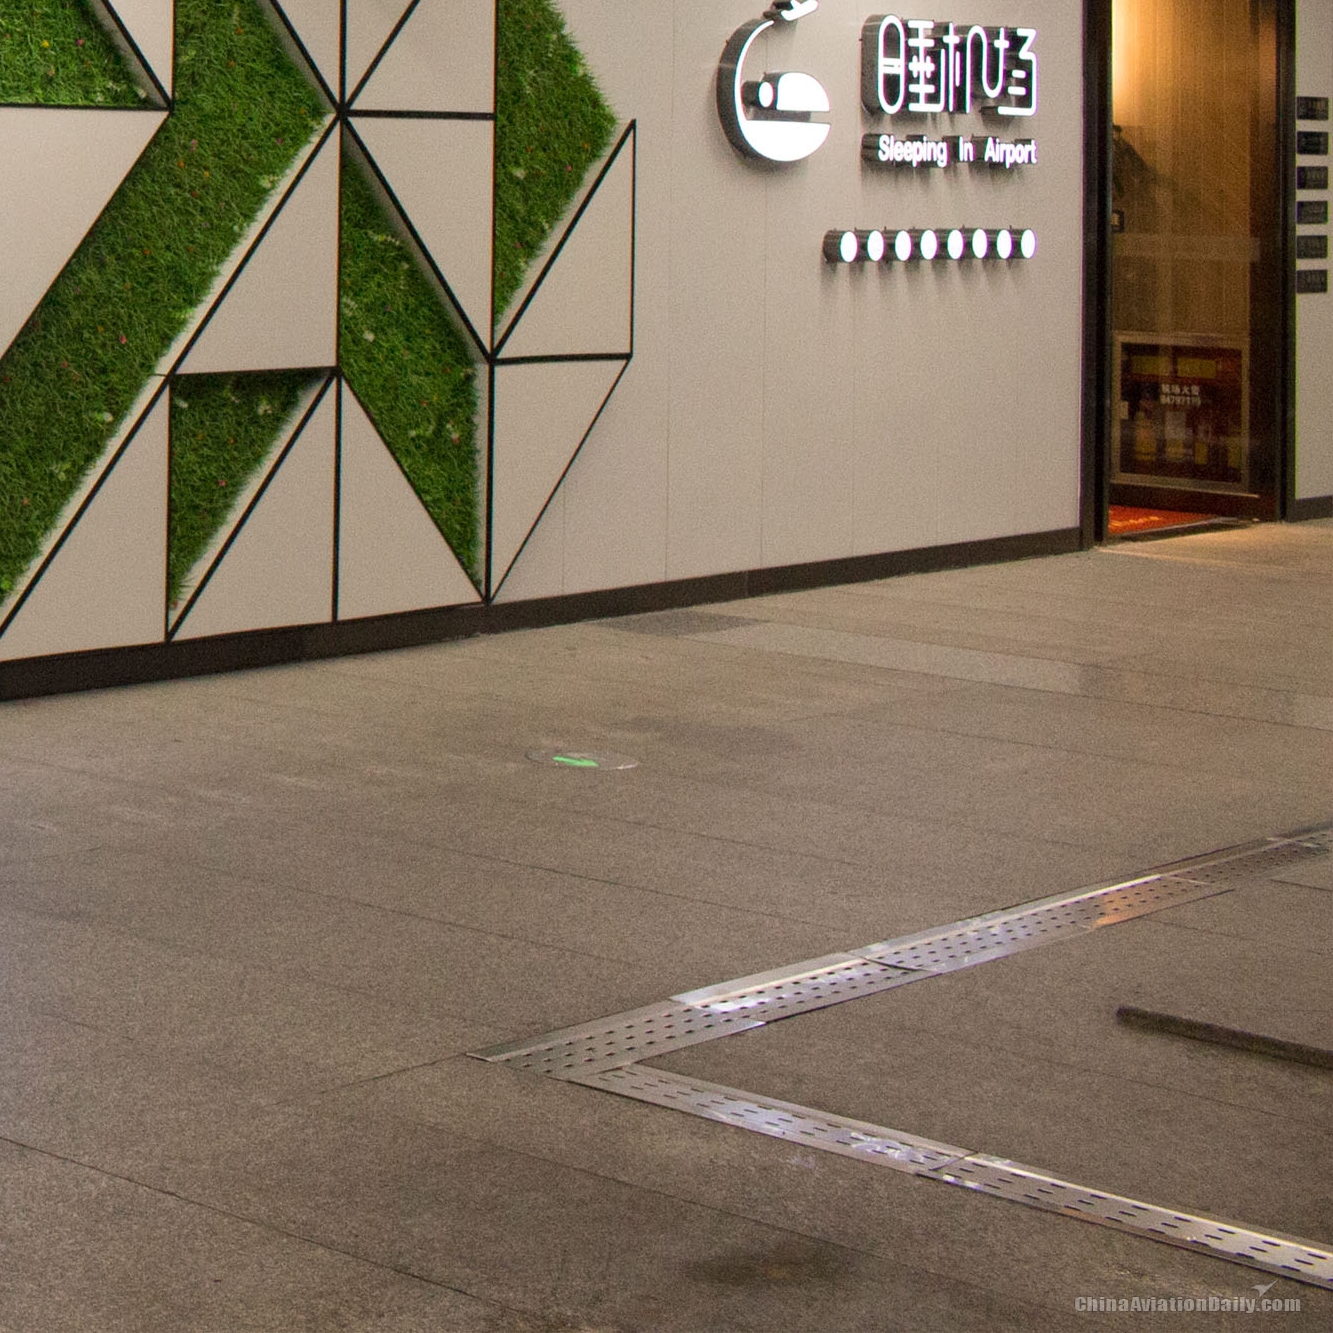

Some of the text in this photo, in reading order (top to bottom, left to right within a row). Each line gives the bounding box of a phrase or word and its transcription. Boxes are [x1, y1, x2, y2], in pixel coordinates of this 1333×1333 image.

[877, 133, 1038, 169] Sleeping In Airport
